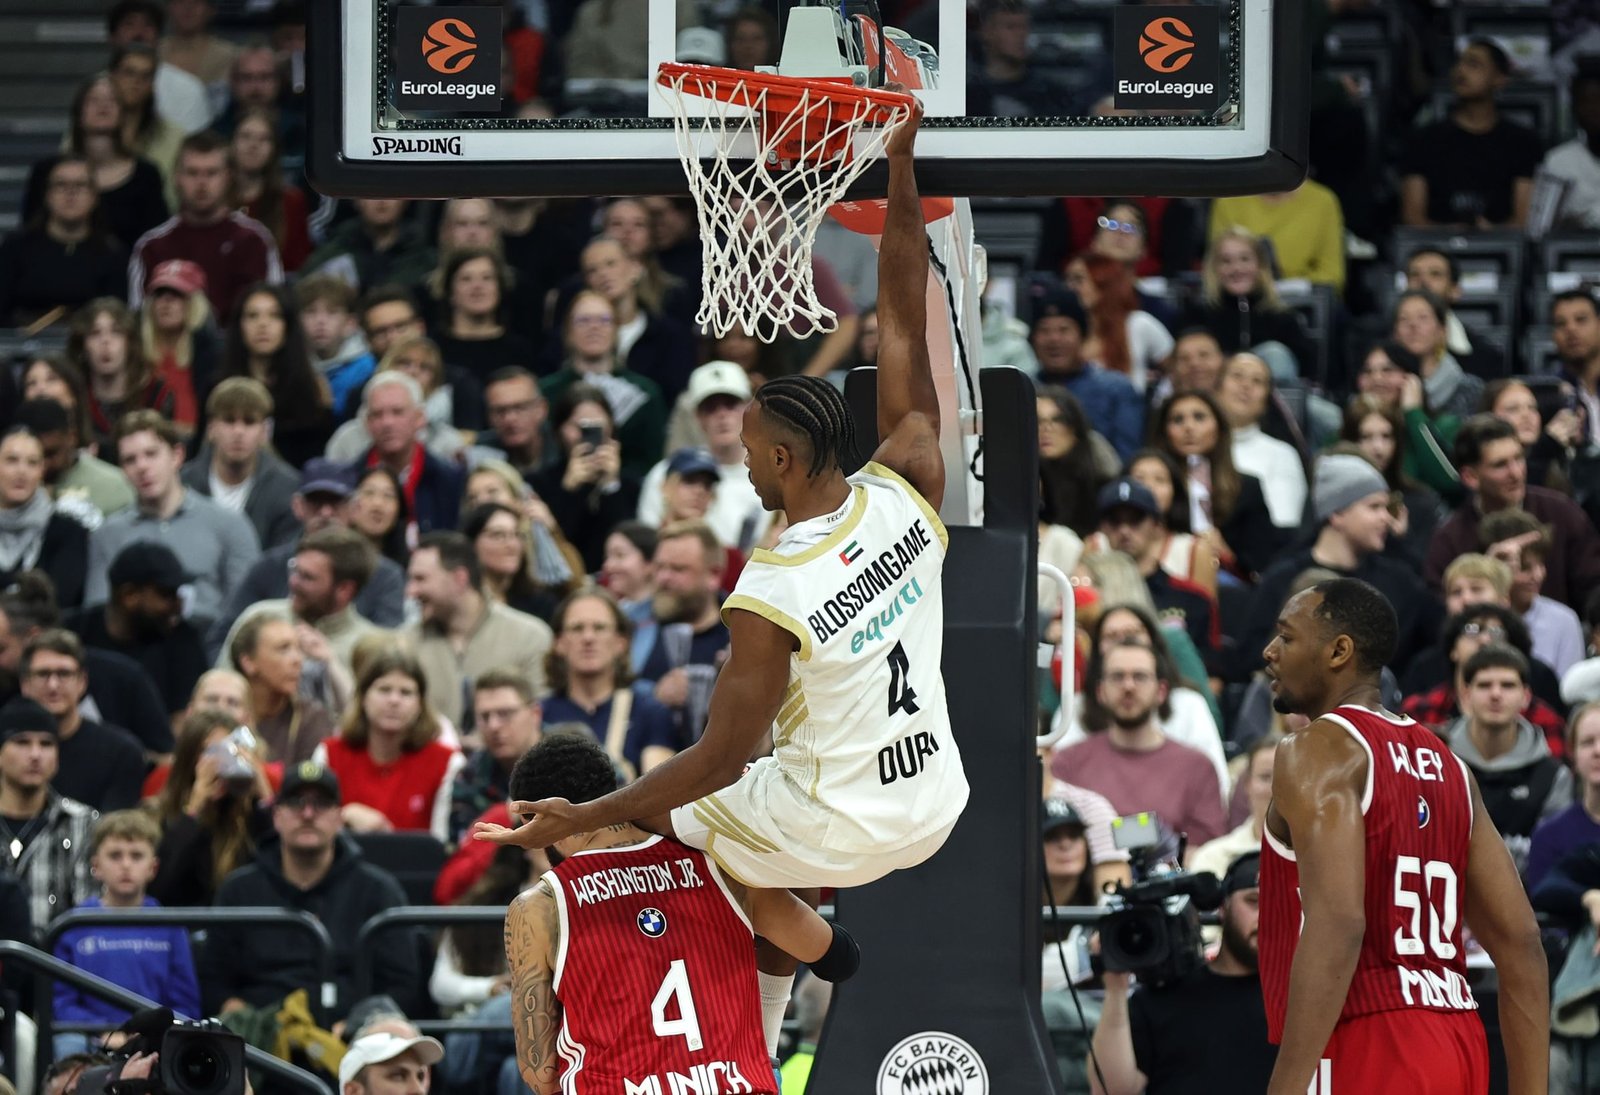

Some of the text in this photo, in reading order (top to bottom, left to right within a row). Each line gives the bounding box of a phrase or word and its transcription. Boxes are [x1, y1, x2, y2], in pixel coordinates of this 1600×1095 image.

[401, 81, 496, 99] EuroLeague
[1118, 80, 1214, 99] EuroLeague
[372, 136, 461, 156] SPALDING
[808, 518, 931, 645] BLOSSOMGAME
[886, 639, 920, 717] 4
[570, 857, 704, 909] WASHINGTON JR.
[1394, 854, 1458, 959] 50
[650, 959, 704, 1052] 4
[1397, 965, 1479, 1010] MUNIC
[887, 1040, 979, 1081] FC BAYERN
